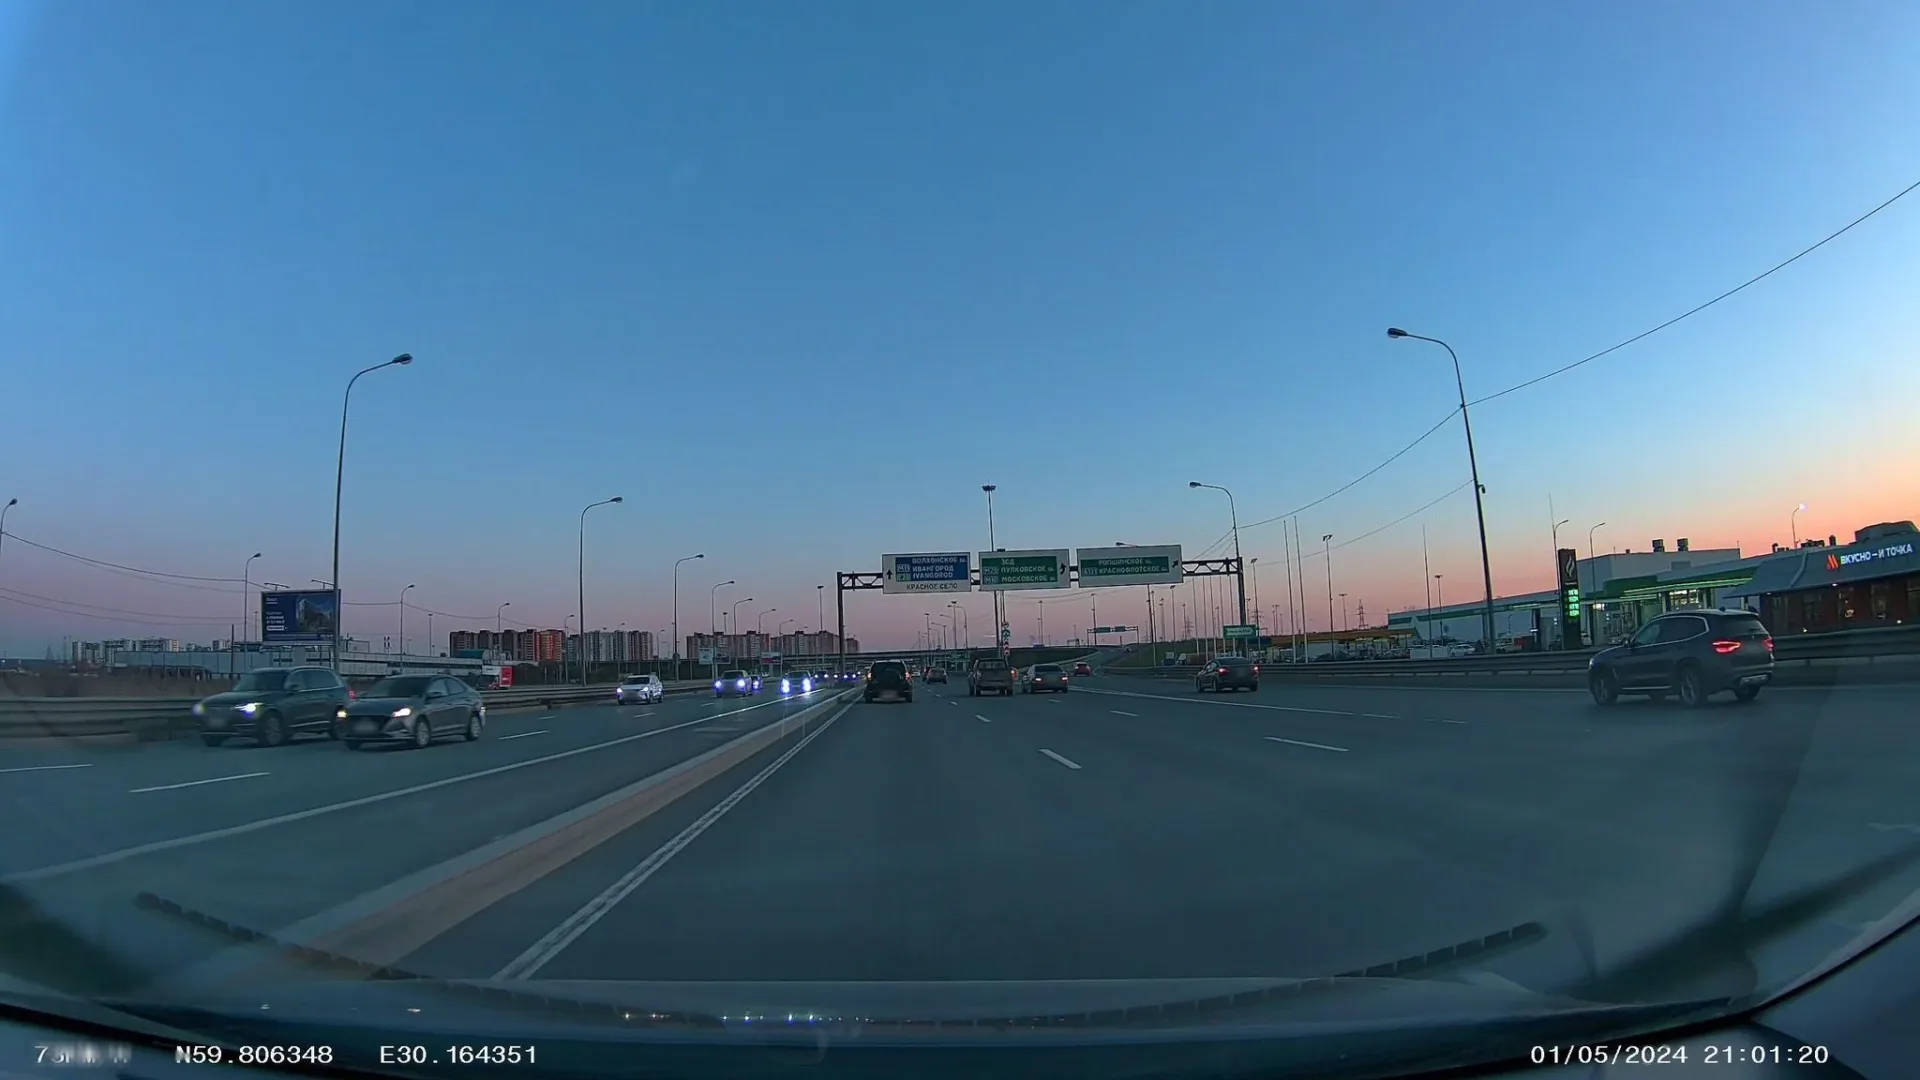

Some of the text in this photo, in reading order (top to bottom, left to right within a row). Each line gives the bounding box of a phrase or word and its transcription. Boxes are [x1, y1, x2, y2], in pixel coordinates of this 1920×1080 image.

[1840, 551, 1871, 565] ВКУСНО
[1885, 543, 1913, 557] ТОЧКА
[1001, 565, 1046, 573] ПУЛКОВСКОЕ
[1099, 566, 1160, 574] КРАСНОФЛОТСКОЕ
[1001, 575, 1048, 583] МОСКОВСКОЕ
[939, 582, 958, 590] СЕЛО
